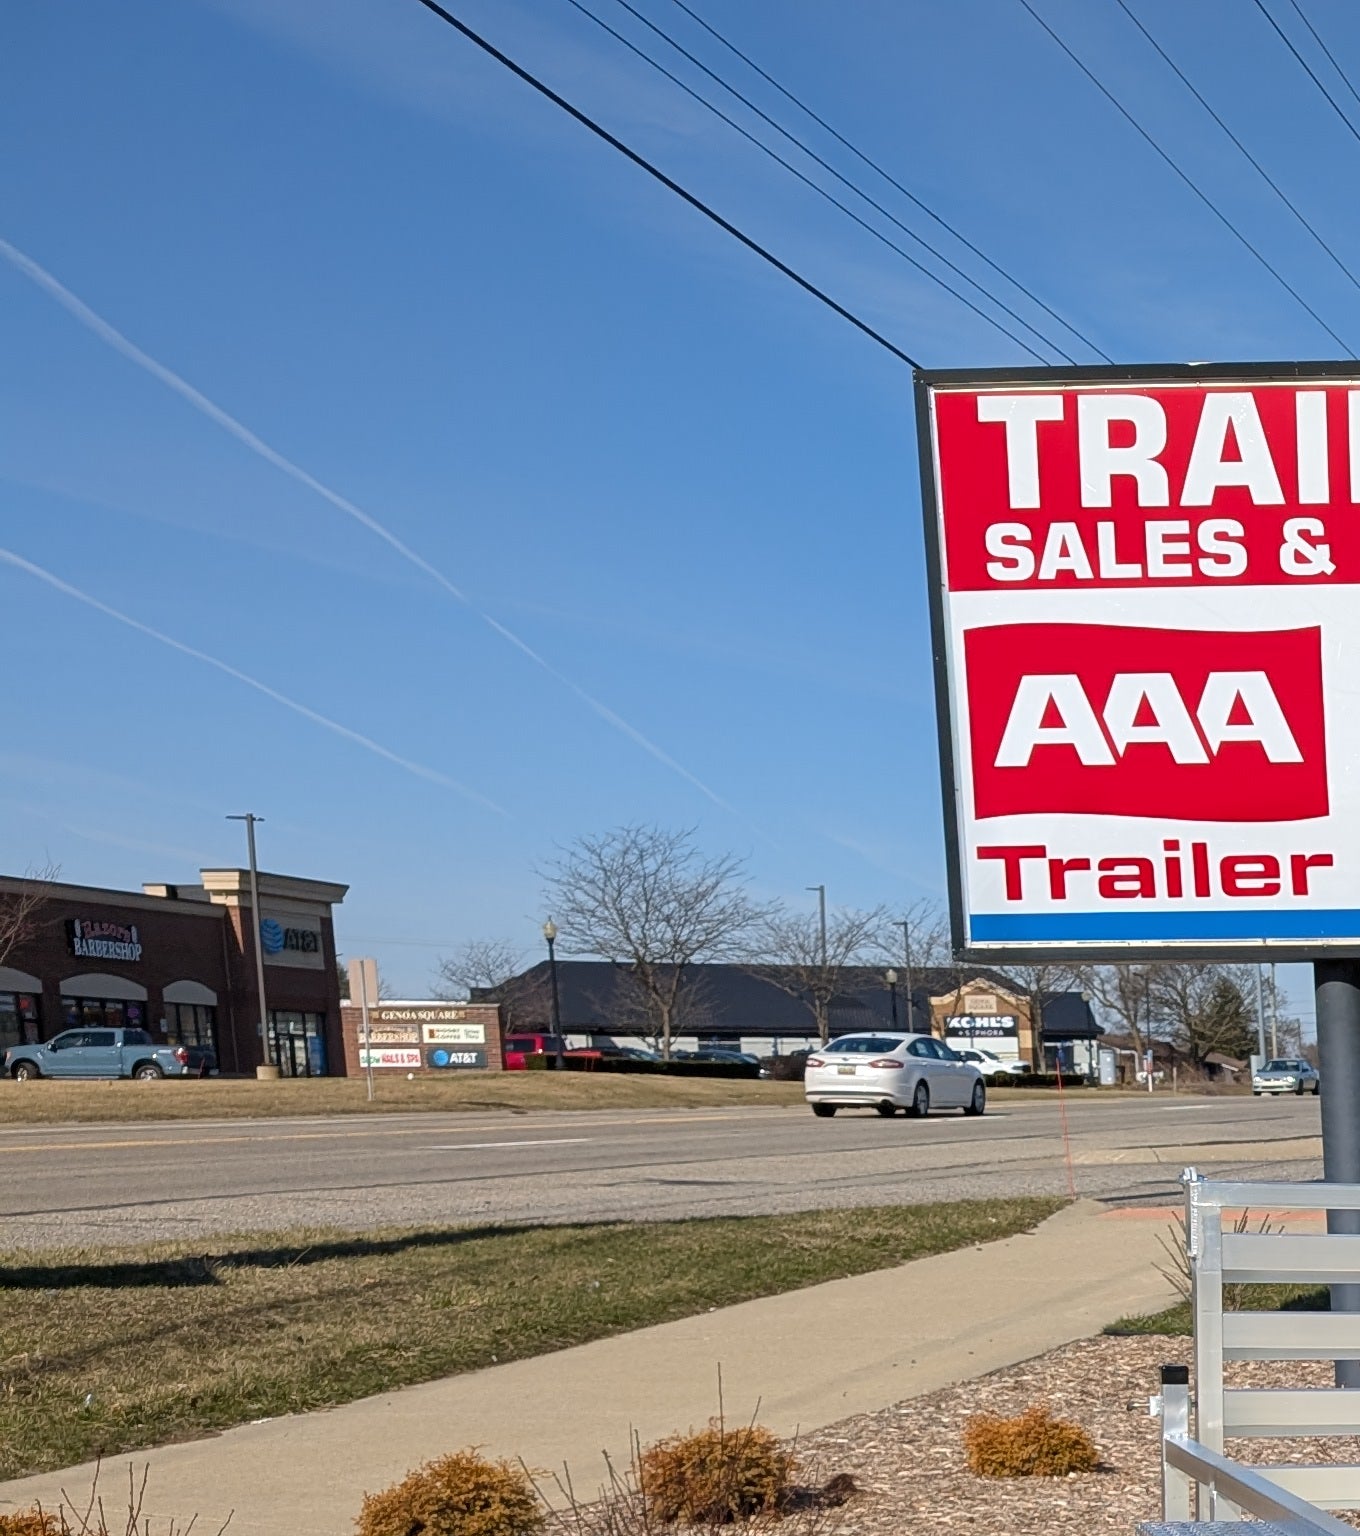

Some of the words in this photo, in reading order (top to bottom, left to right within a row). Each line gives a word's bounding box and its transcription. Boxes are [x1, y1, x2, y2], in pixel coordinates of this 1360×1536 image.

[984, 518, 1248, 582] SALES
[1278, 517, 1336, 576] &
[993, 670, 1305, 767] AAA
[975, 838, 1334, 901] Trailer
[74, 937, 142, 961] BARBERSHOP
[381, 1010, 417, 1020] GENOA
[418, 1010, 458, 1021] SQUARE
[946, 1016, 1014, 1028] KOHL'S
[450, 1052, 478, 1064] AT&T
